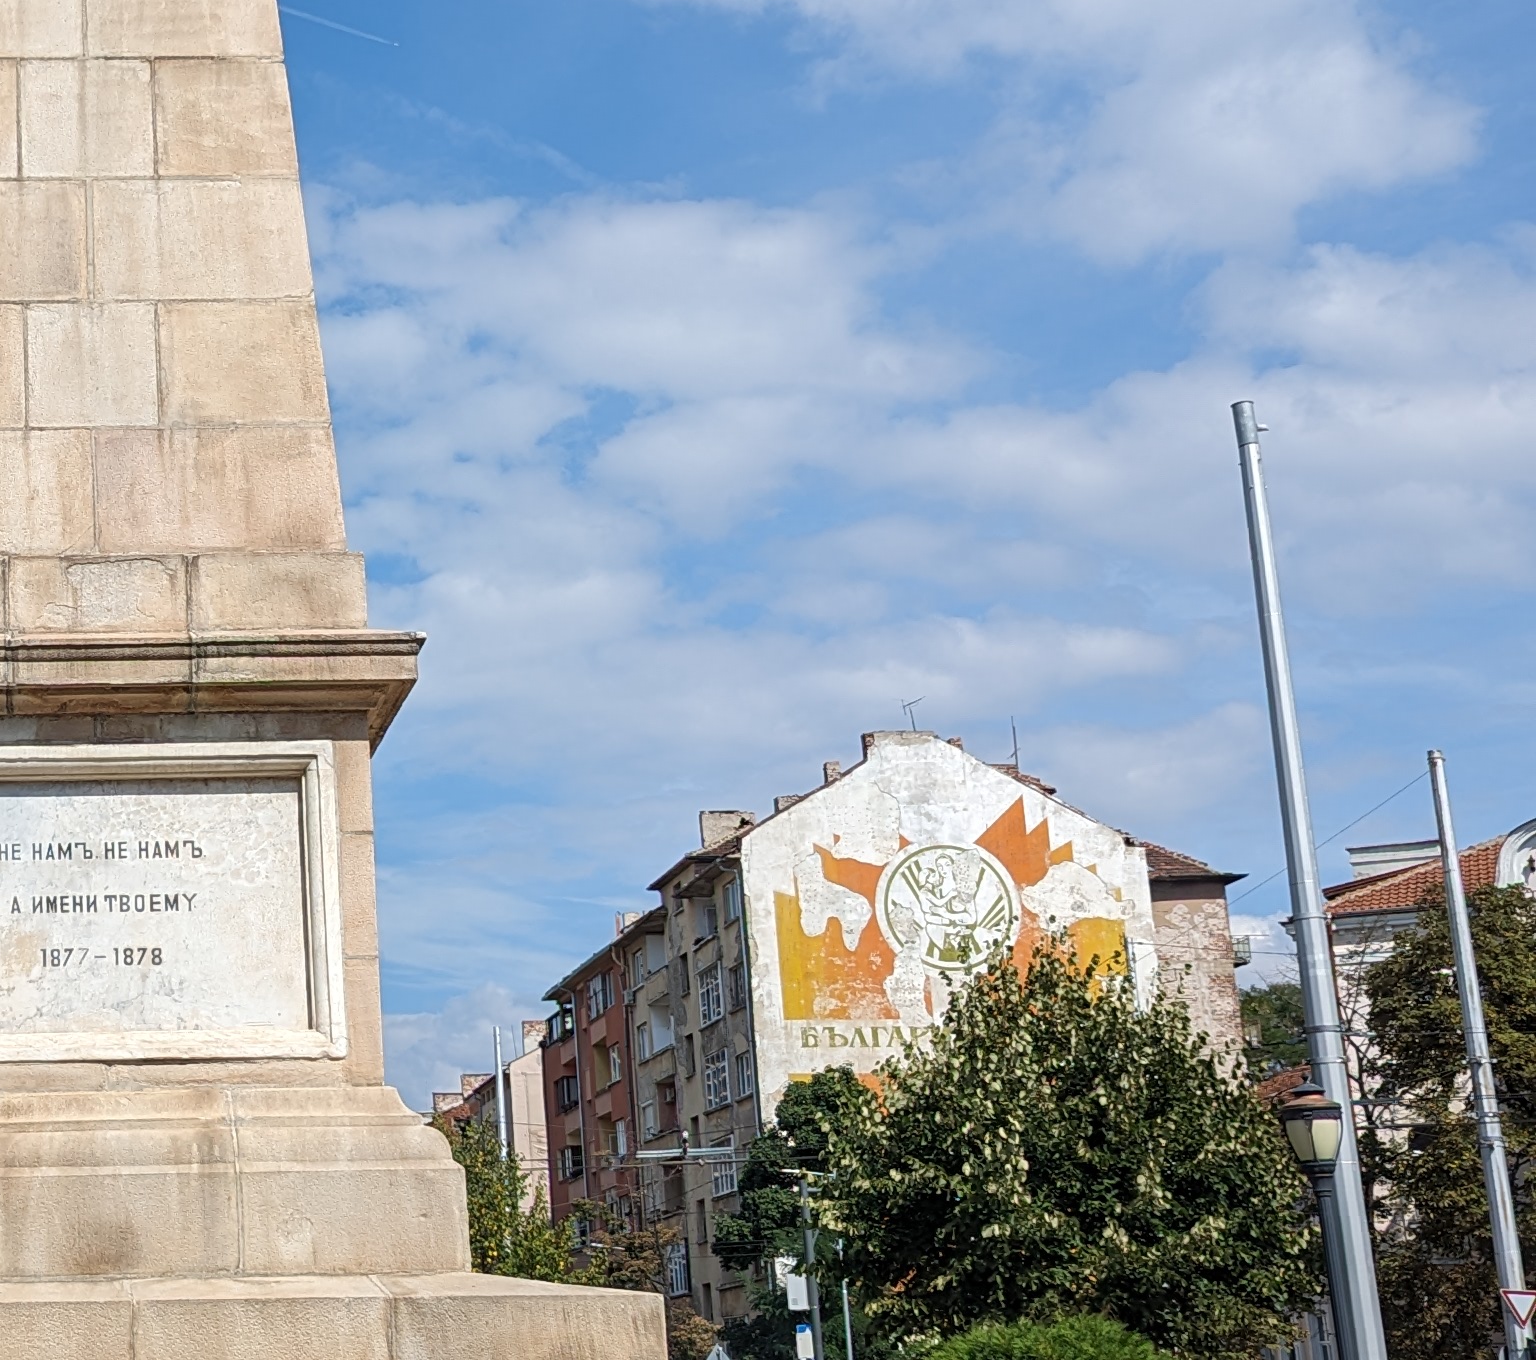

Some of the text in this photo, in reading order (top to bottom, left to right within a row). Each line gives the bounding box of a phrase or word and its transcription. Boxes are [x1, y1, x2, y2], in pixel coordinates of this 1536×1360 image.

[104, 841, 128, 860] НЕ
[11, 896, 21, 914] А
[32, 894, 98, 913] ИМЕНИ
[800, 1026, 934, 1048] БЪЛГАР
